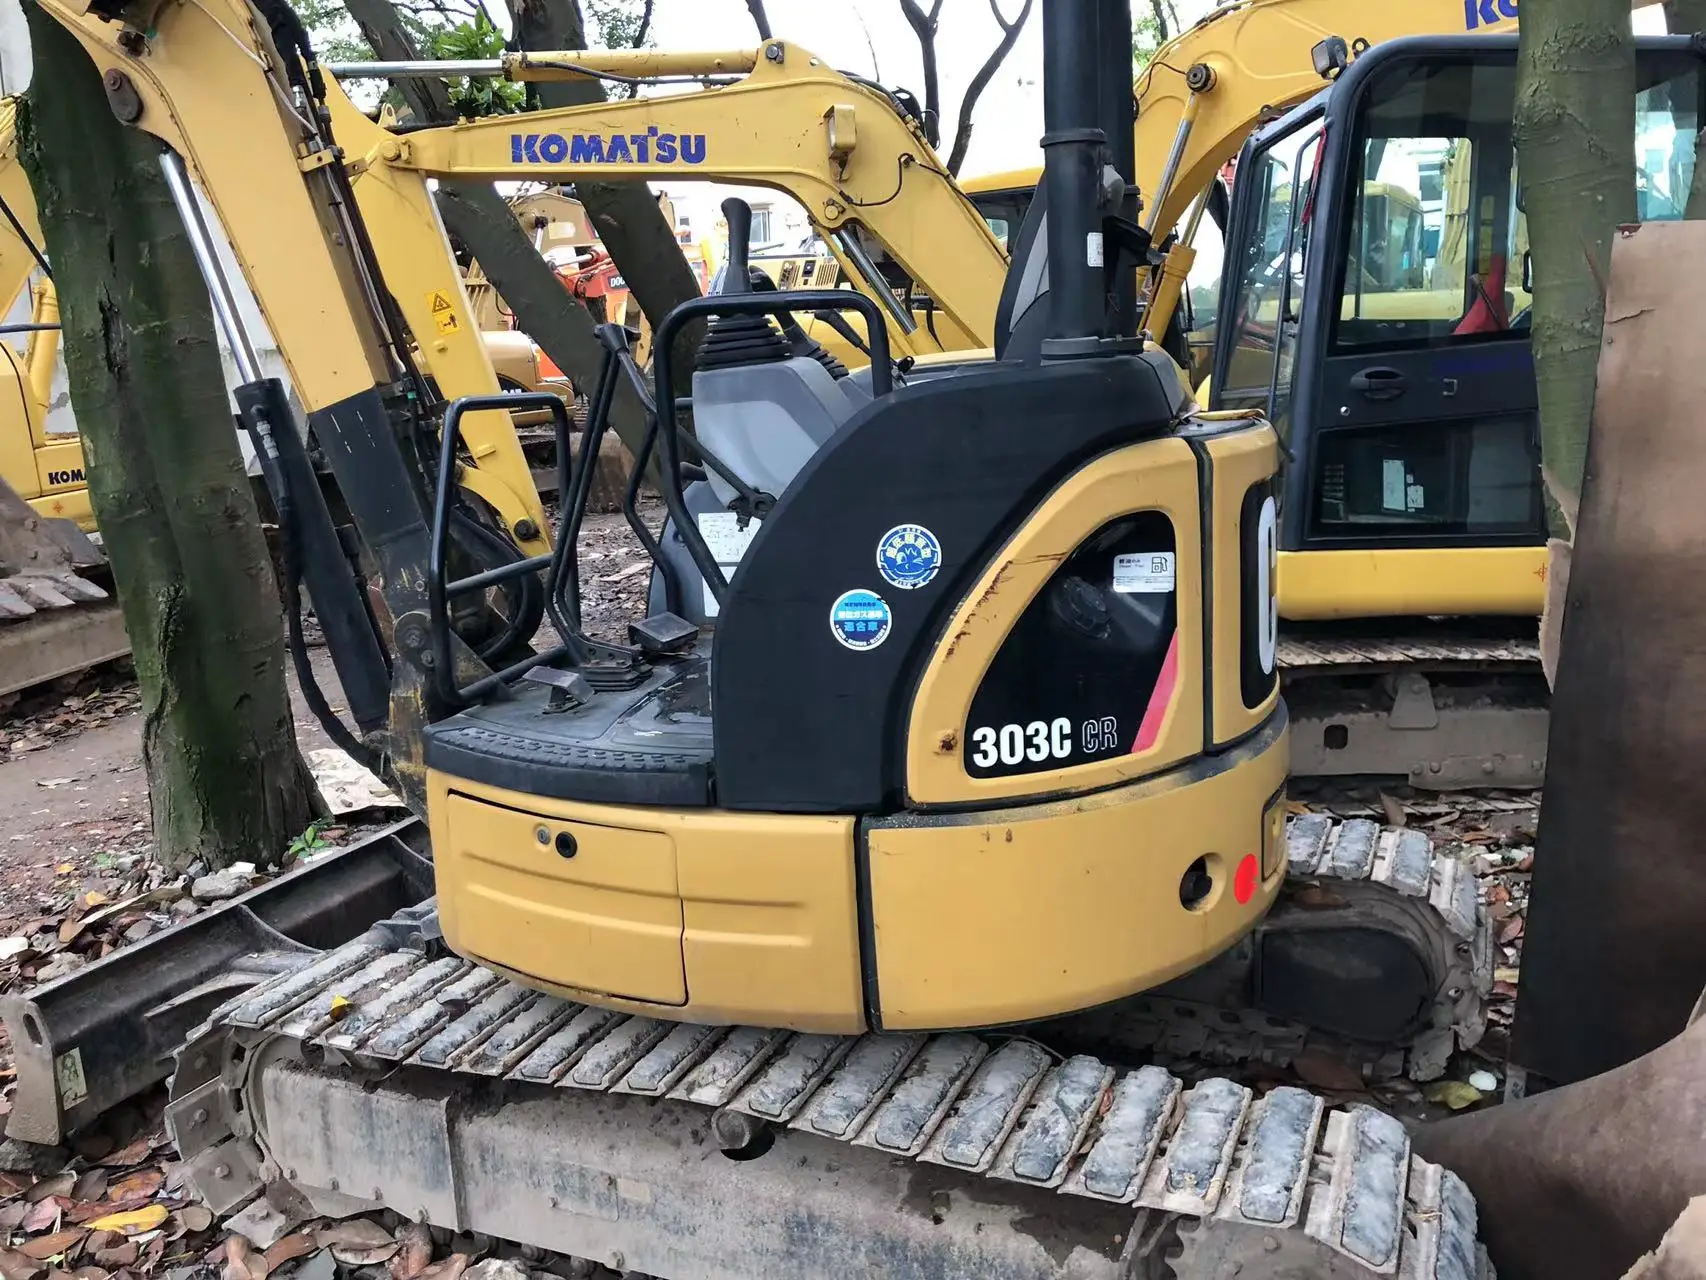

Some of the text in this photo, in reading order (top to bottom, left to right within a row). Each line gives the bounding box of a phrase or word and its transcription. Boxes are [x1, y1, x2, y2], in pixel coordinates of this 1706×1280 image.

[511, 126, 706, 164] KOMATSU
[972, 716, 1118, 768] 303C CR
